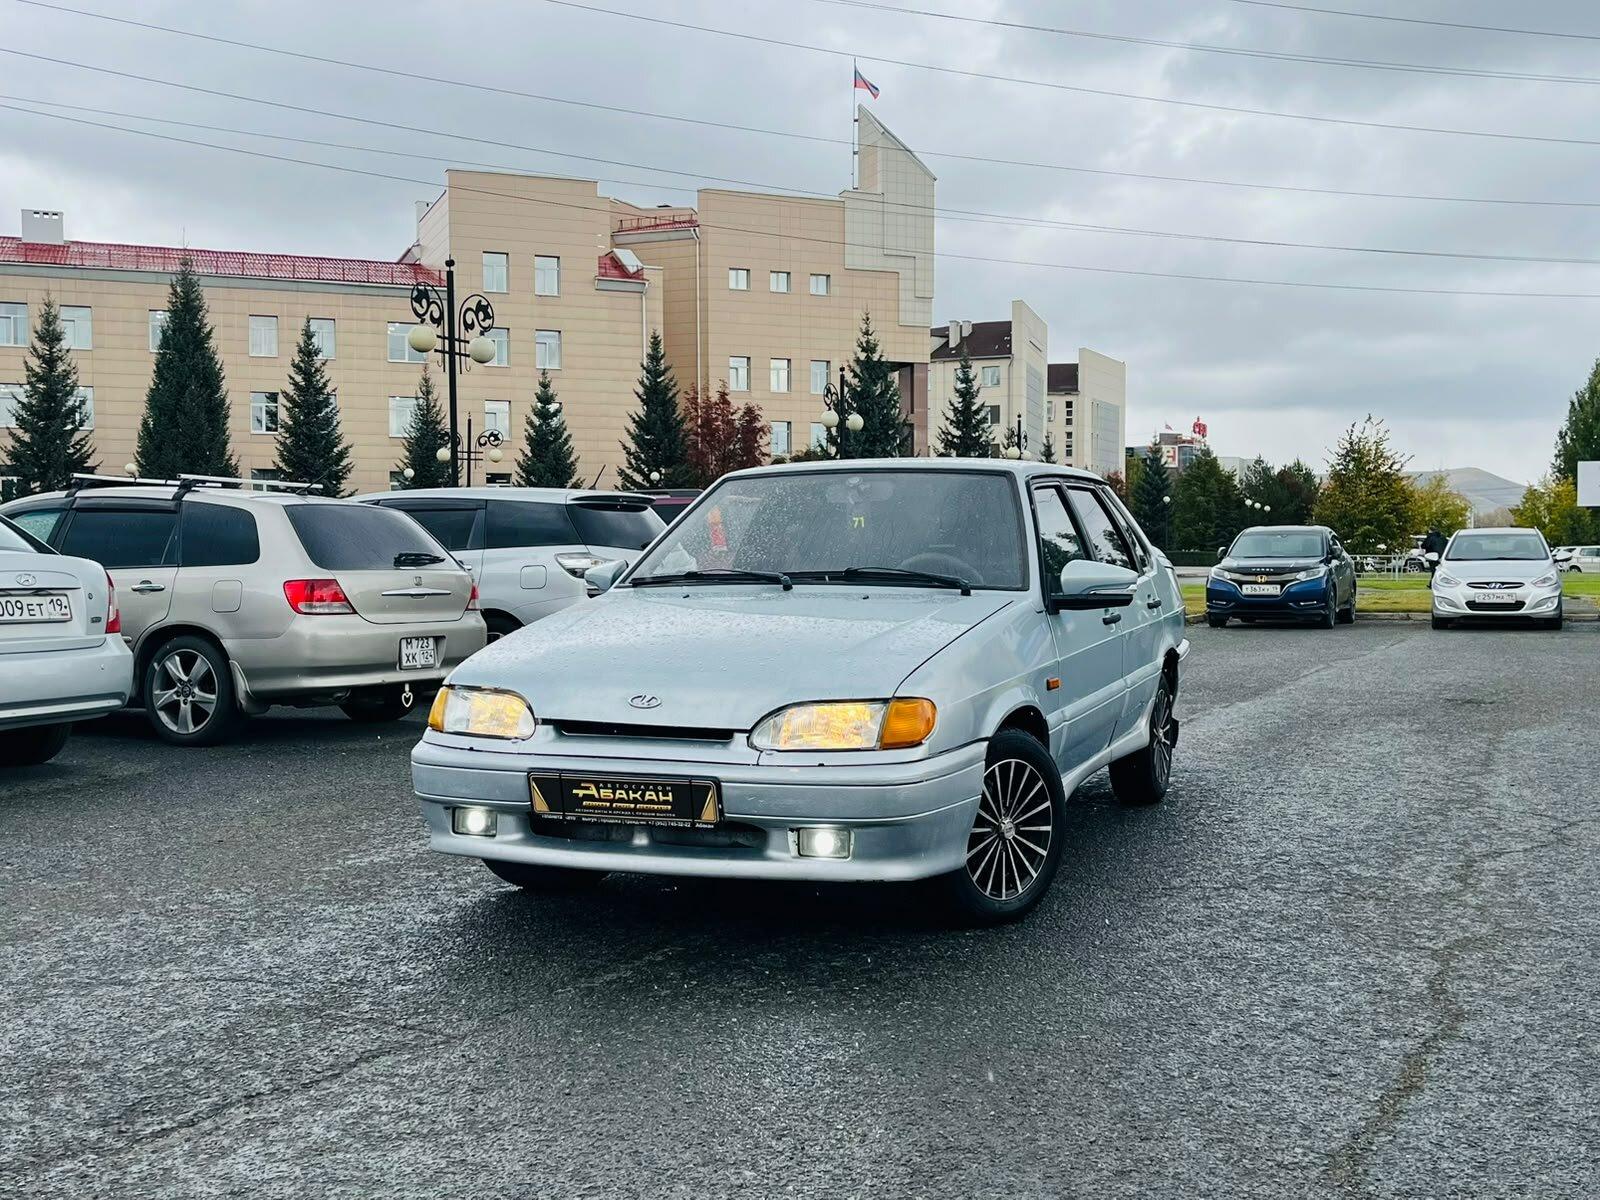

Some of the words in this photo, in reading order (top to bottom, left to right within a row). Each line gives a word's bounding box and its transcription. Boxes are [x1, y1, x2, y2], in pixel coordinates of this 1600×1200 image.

[852, 512, 865, 529] 71
[48, 598, 63, 612] 19
[405, 652, 418, 664] ХК
[573, 783, 673, 802] АБАКАН
